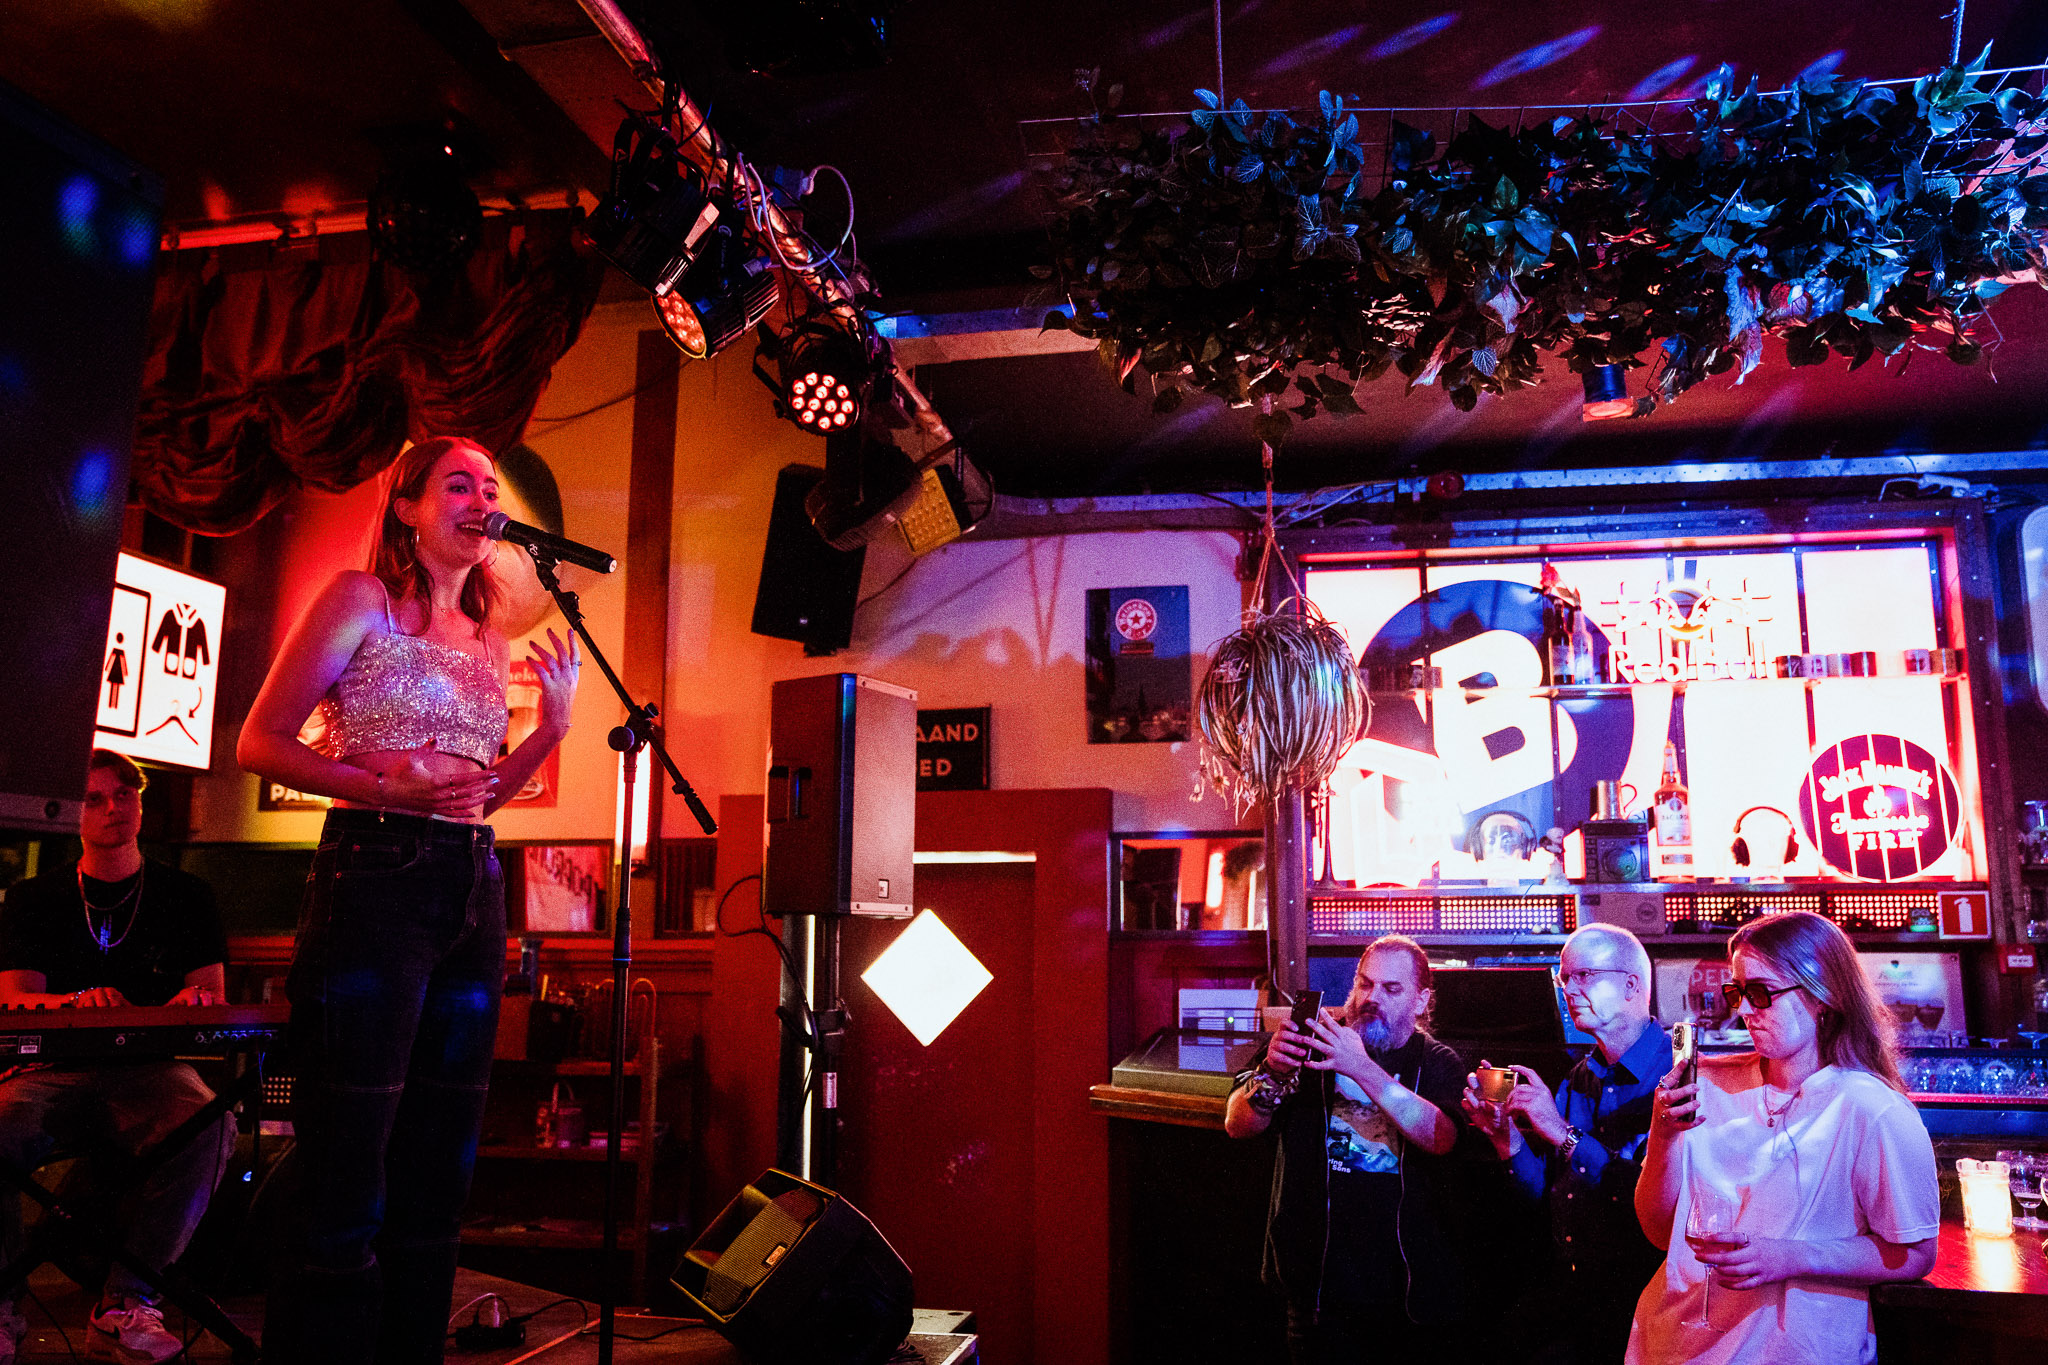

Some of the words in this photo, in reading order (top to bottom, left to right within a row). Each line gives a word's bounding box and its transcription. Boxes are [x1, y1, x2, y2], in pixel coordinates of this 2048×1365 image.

[1608, 640, 1688, 684] Red
[1693, 639, 1773, 682] Bull
[916, 757, 953, 778] ED
[1849, 831, 1923, 851] FIRE
